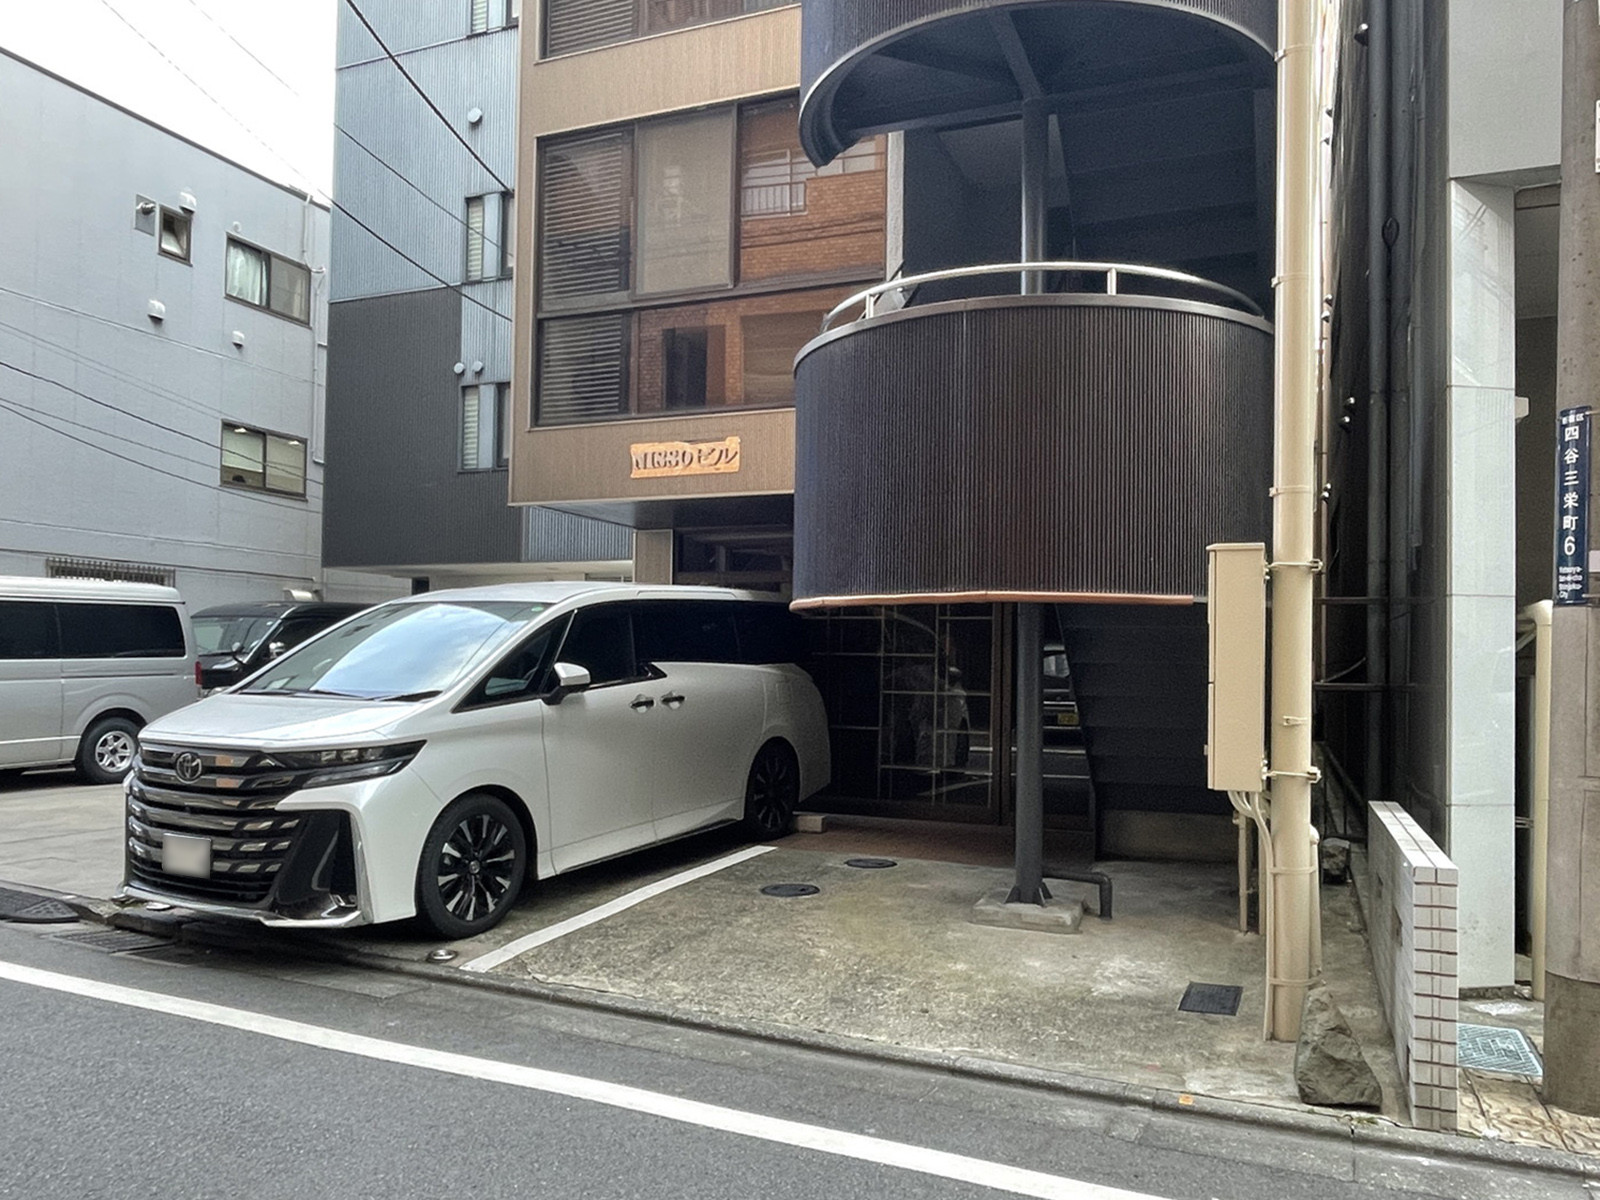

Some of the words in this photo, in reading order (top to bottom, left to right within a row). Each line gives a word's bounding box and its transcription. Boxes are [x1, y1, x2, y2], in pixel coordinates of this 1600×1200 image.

[1562, 425, 1580, 556] 四谷三栄町6
